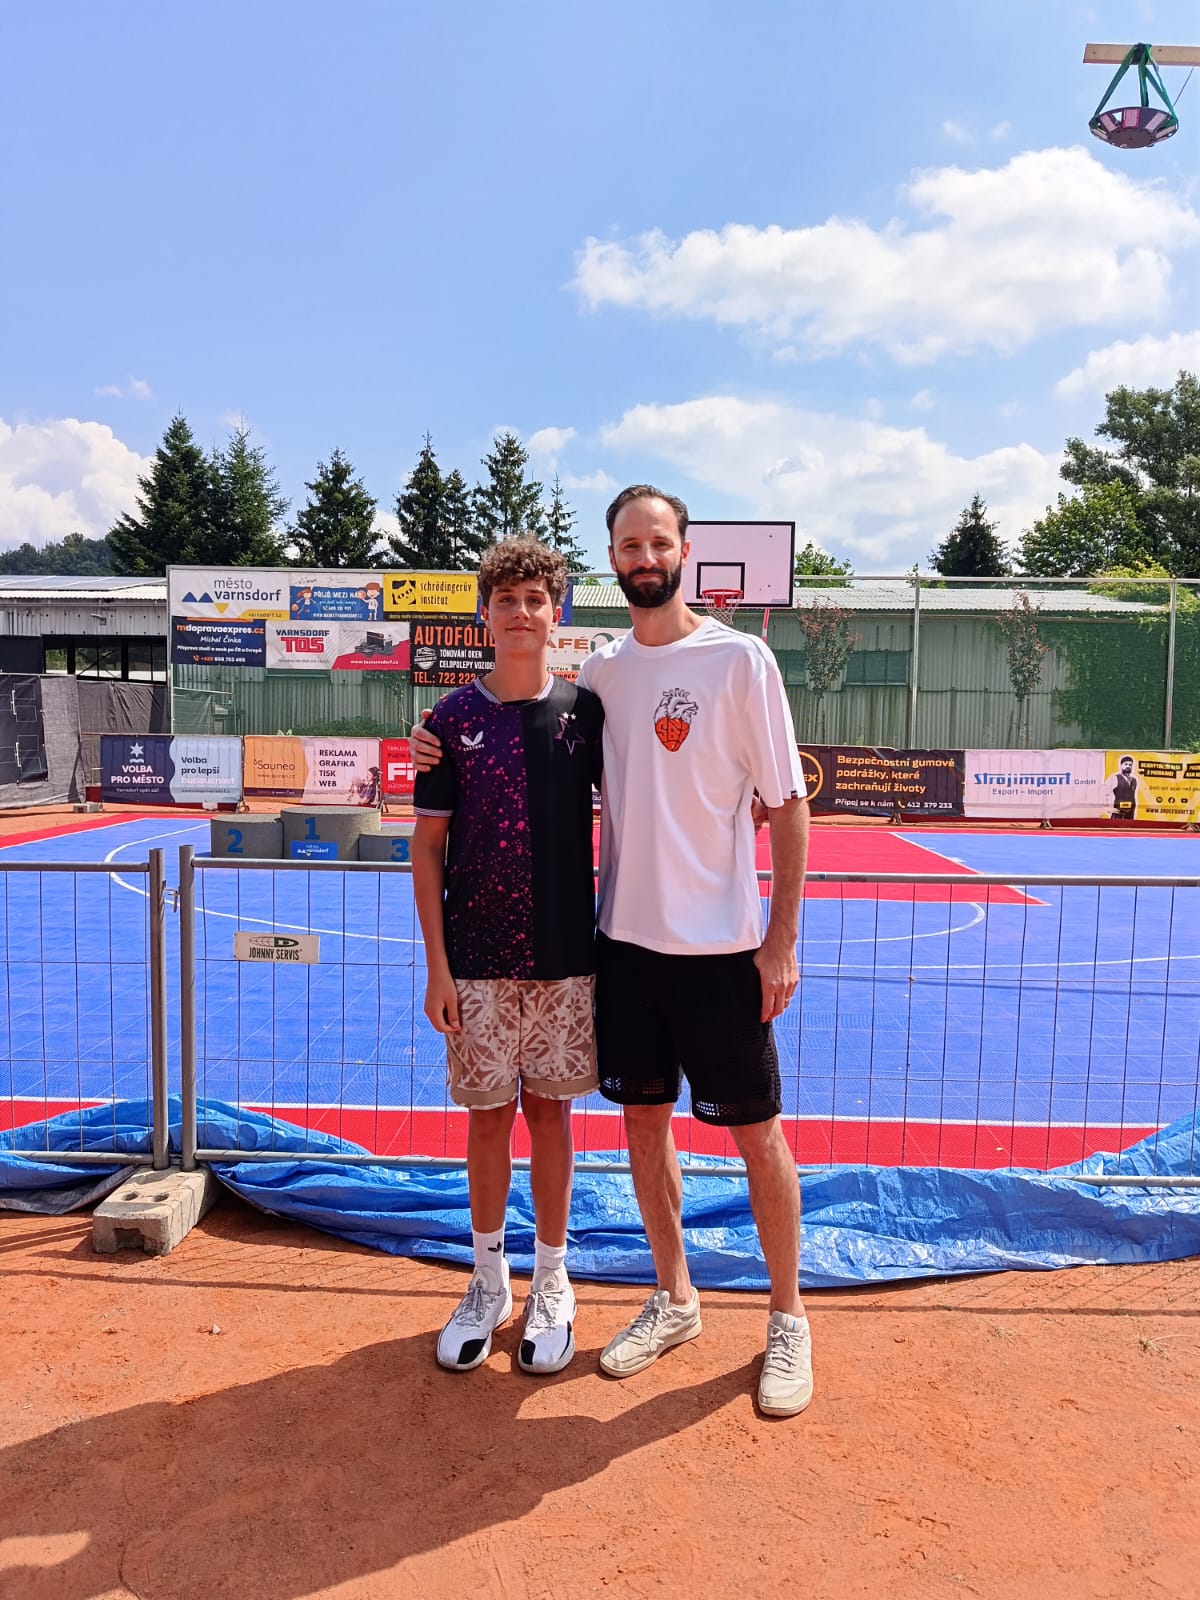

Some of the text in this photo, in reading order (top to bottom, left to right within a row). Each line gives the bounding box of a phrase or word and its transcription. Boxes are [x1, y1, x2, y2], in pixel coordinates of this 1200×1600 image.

[214, 577, 253, 589] město
[420, 580, 472, 593] schrödingerův
[214, 589, 282, 601] varnsdorf
[420, 594, 448, 605] institut
[176, 624, 265, 635] mdopravaexpres.cz
[276, 629, 330, 637] VARNSDORF
[280, 637, 325, 653] TOS
[546, 636, 589, 649] AFÉ
[468, 650, 483, 658] OKEN
[474, 661, 496, 670] VOZIDE
[413, 671, 476, 684] TEL.: 722 222
[319, 749, 358, 757] REKLAMA
[181, 756, 208, 764] Volba
[257, 760, 296, 770] Sauneo
[319, 759, 355, 767] GRAFIKA
[837, 755, 955, 769] Bezpečnostní gumové
[121, 765, 153, 773] VOLBA
[181, 766, 220, 776] pro lepší
[319, 769, 336, 777] TISK
[387, 762, 418, 781] Fi
[836, 768, 920, 780] podrážky, které
[110, 774, 165, 784] PRO MĚSTO
[803, 773, 818, 782] EX
[974, 772, 1072, 787] Strojimport
[835, 781, 927, 794] zachraňují životy
[992, 788, 1019, 796] Export
[1027, 788, 1054, 796] Import
[835, 797, 858, 807] Připoj
[870, 799, 876, 807] k
[304, 816, 321, 840] 1
[226, 828, 244, 854] 2
[390, 838, 409, 862] 3
[248, 947, 301, 961] JOHNNY SERVIS
